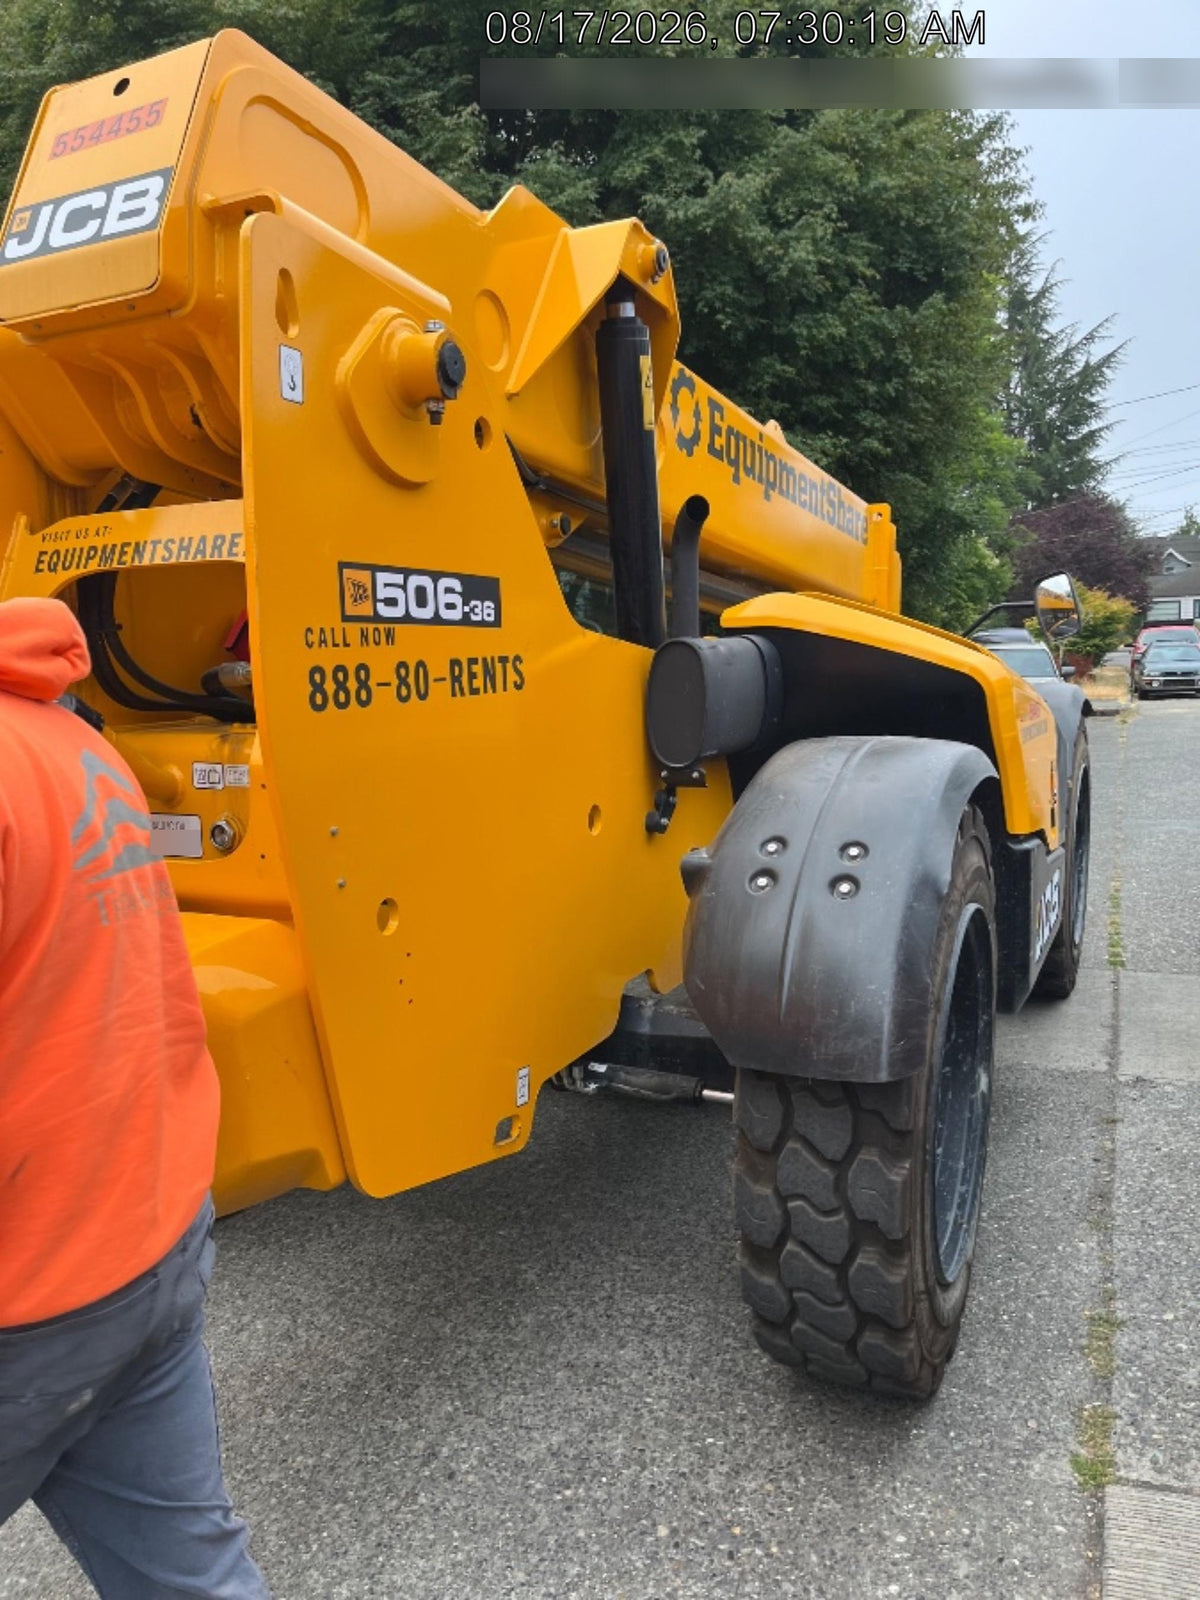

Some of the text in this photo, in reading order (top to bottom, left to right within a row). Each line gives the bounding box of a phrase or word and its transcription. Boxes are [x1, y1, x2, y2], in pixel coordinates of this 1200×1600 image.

[52, 101, 164, 158] 554455
[4, 175, 164, 258] JCB
[706, 396, 868, 546] EquipmentShare
[41, 529, 71, 543] VISIT
[75, 527, 89, 539] US
[305, 626, 396, 649] CALL NOW
[309, 654, 525, 712] 888-80-RENTS
